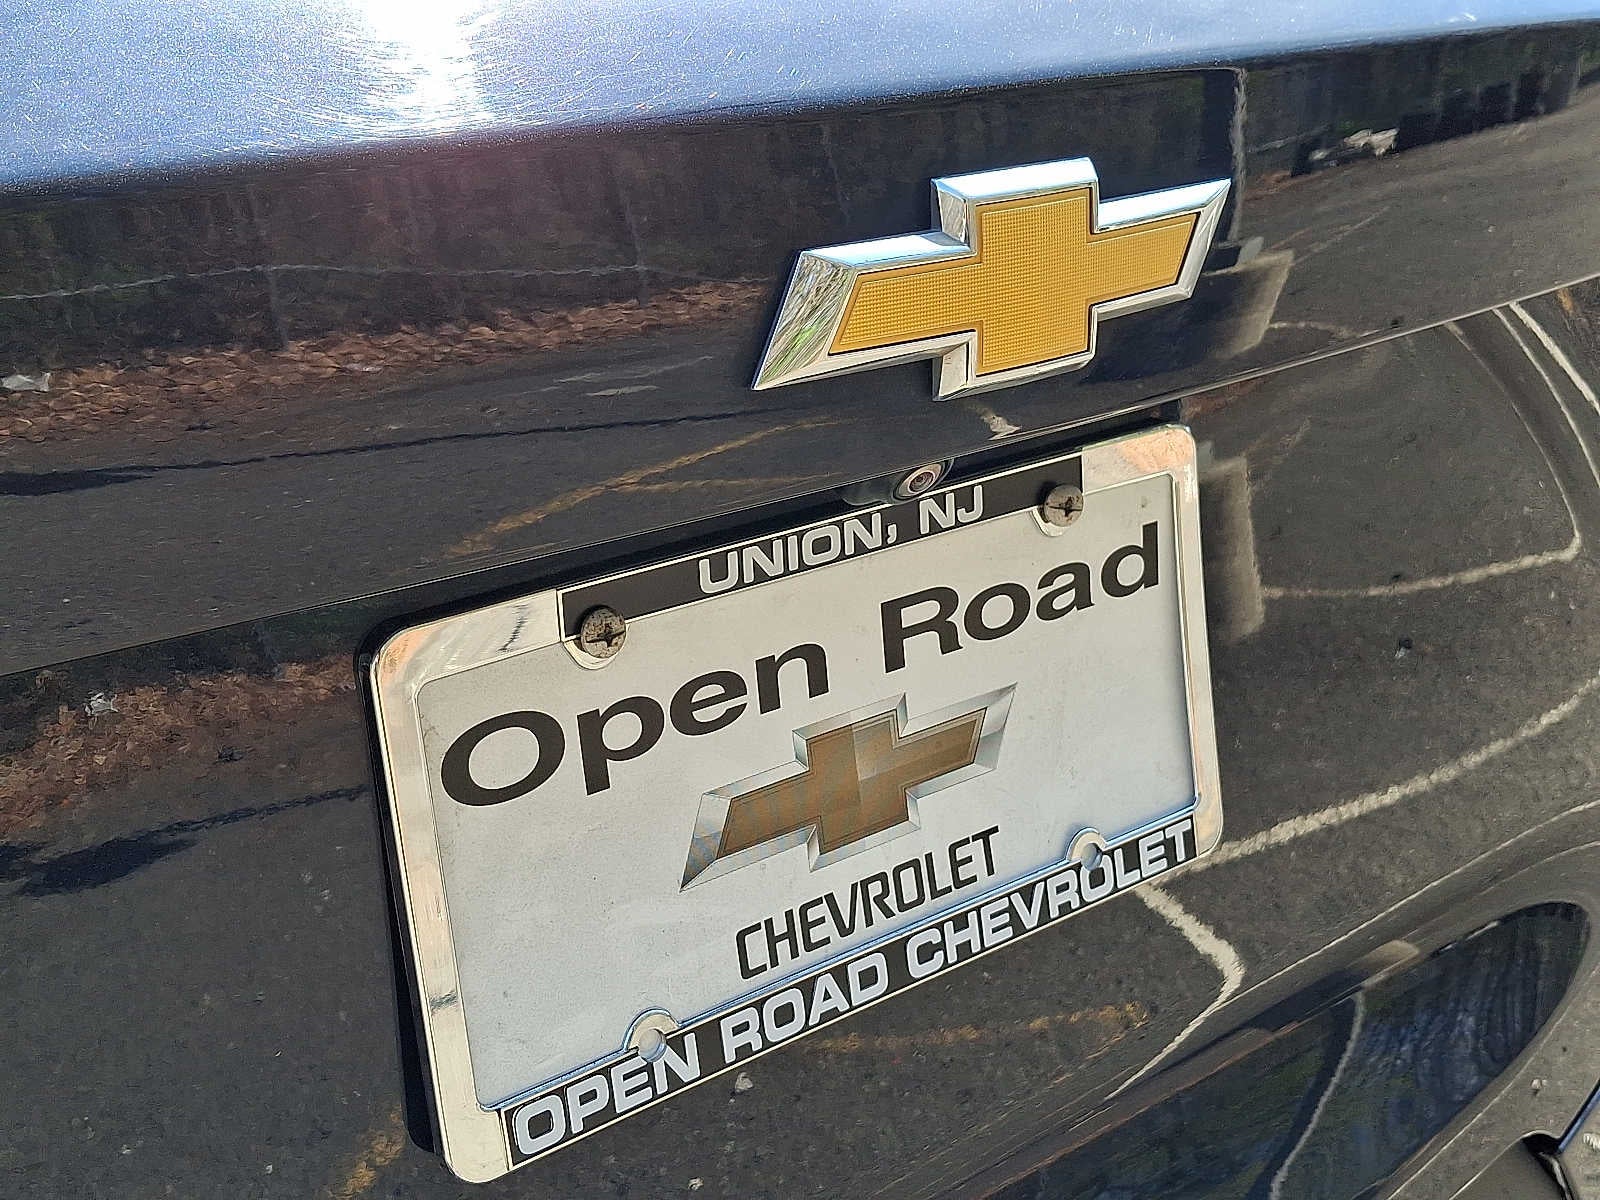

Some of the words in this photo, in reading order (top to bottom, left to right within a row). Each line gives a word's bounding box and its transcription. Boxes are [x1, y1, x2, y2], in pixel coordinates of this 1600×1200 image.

[698, 512, 899, 596] UNION,
[917, 485, 985, 536] NJ
[440, 641, 829, 808] Open
[879, 521, 1161, 673] Road
[512, 1032, 702, 1156] OPEN
[721, 953, 890, 1065] ROAD
[906, 820, 1193, 979] CHEVROLET
[735, 825, 1000, 980] CHEVROLET
